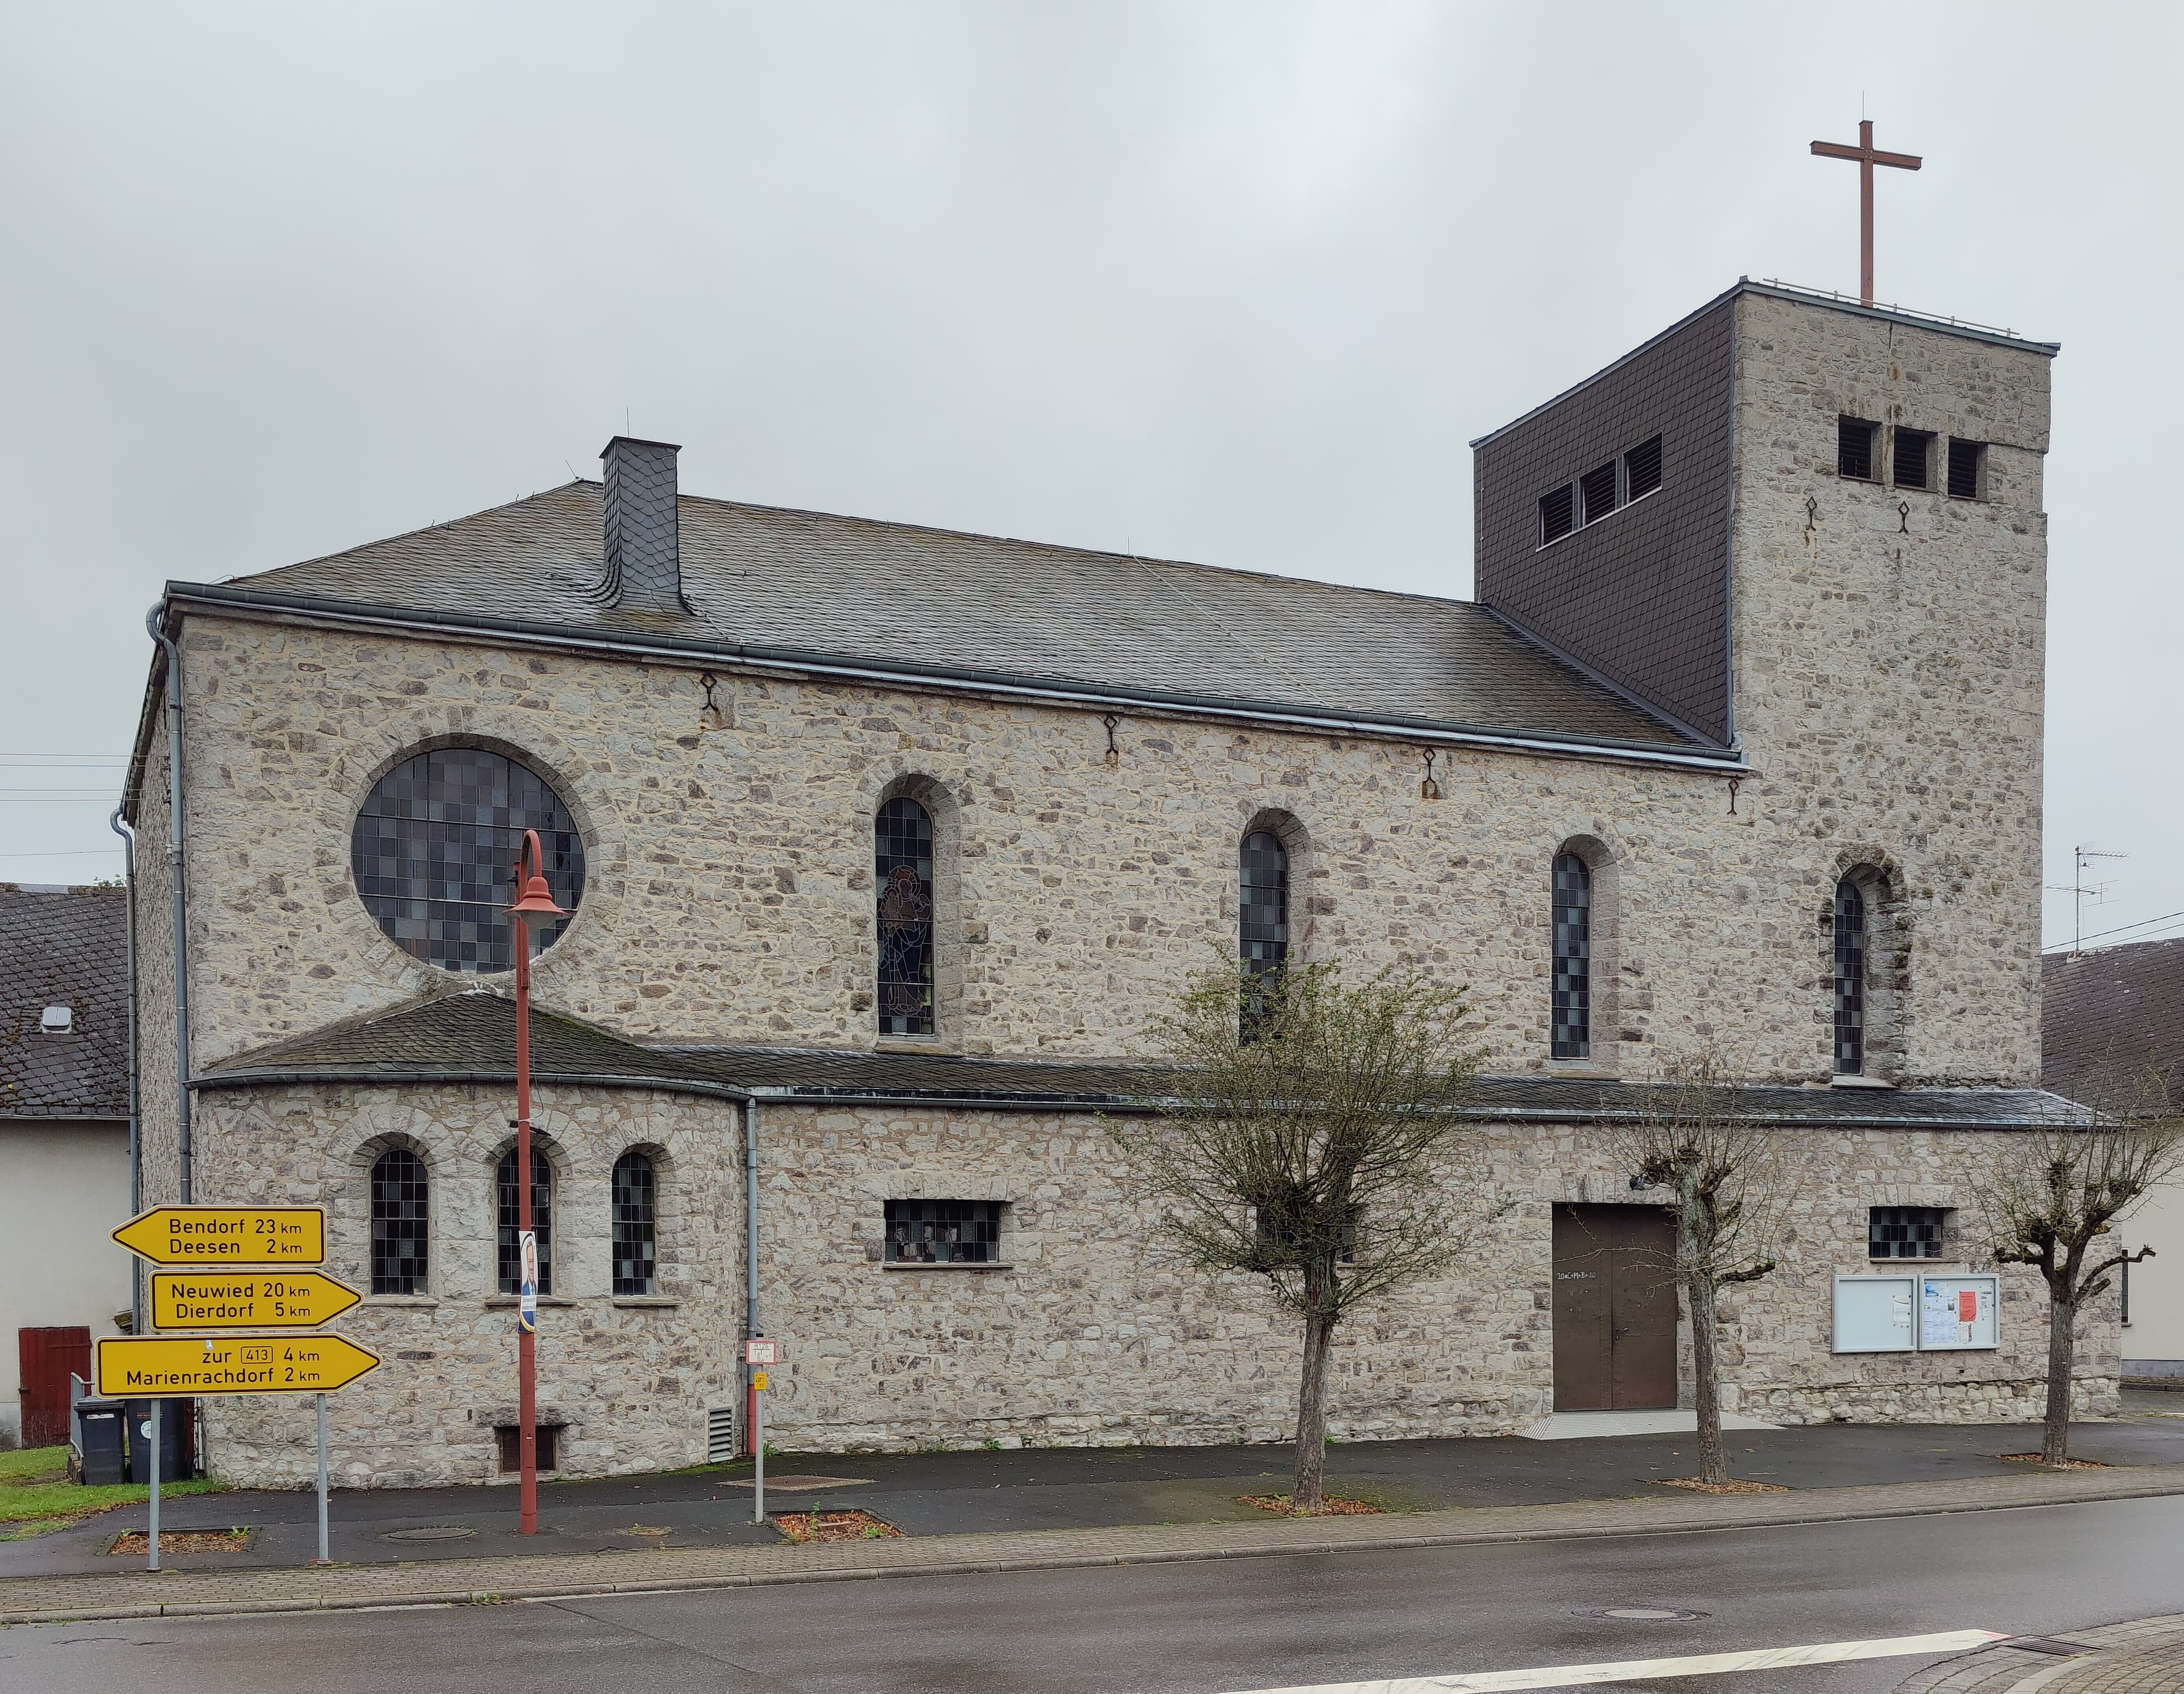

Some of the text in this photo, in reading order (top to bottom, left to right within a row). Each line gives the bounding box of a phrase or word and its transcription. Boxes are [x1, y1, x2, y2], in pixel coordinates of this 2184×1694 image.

[169, 1219, 301, 1234] Bendorf 23 km
[170, 1239, 302, 1254] Deesen 2 km
[172, 1282, 310, 1298] Neuwied 20 km
[176, 1302, 310, 1319] Dierdorf 5 km
[202, 1347, 320, 1364] zur 413 4 km
[127, 1367, 320, 1386] Marienrachdorf 2 km
